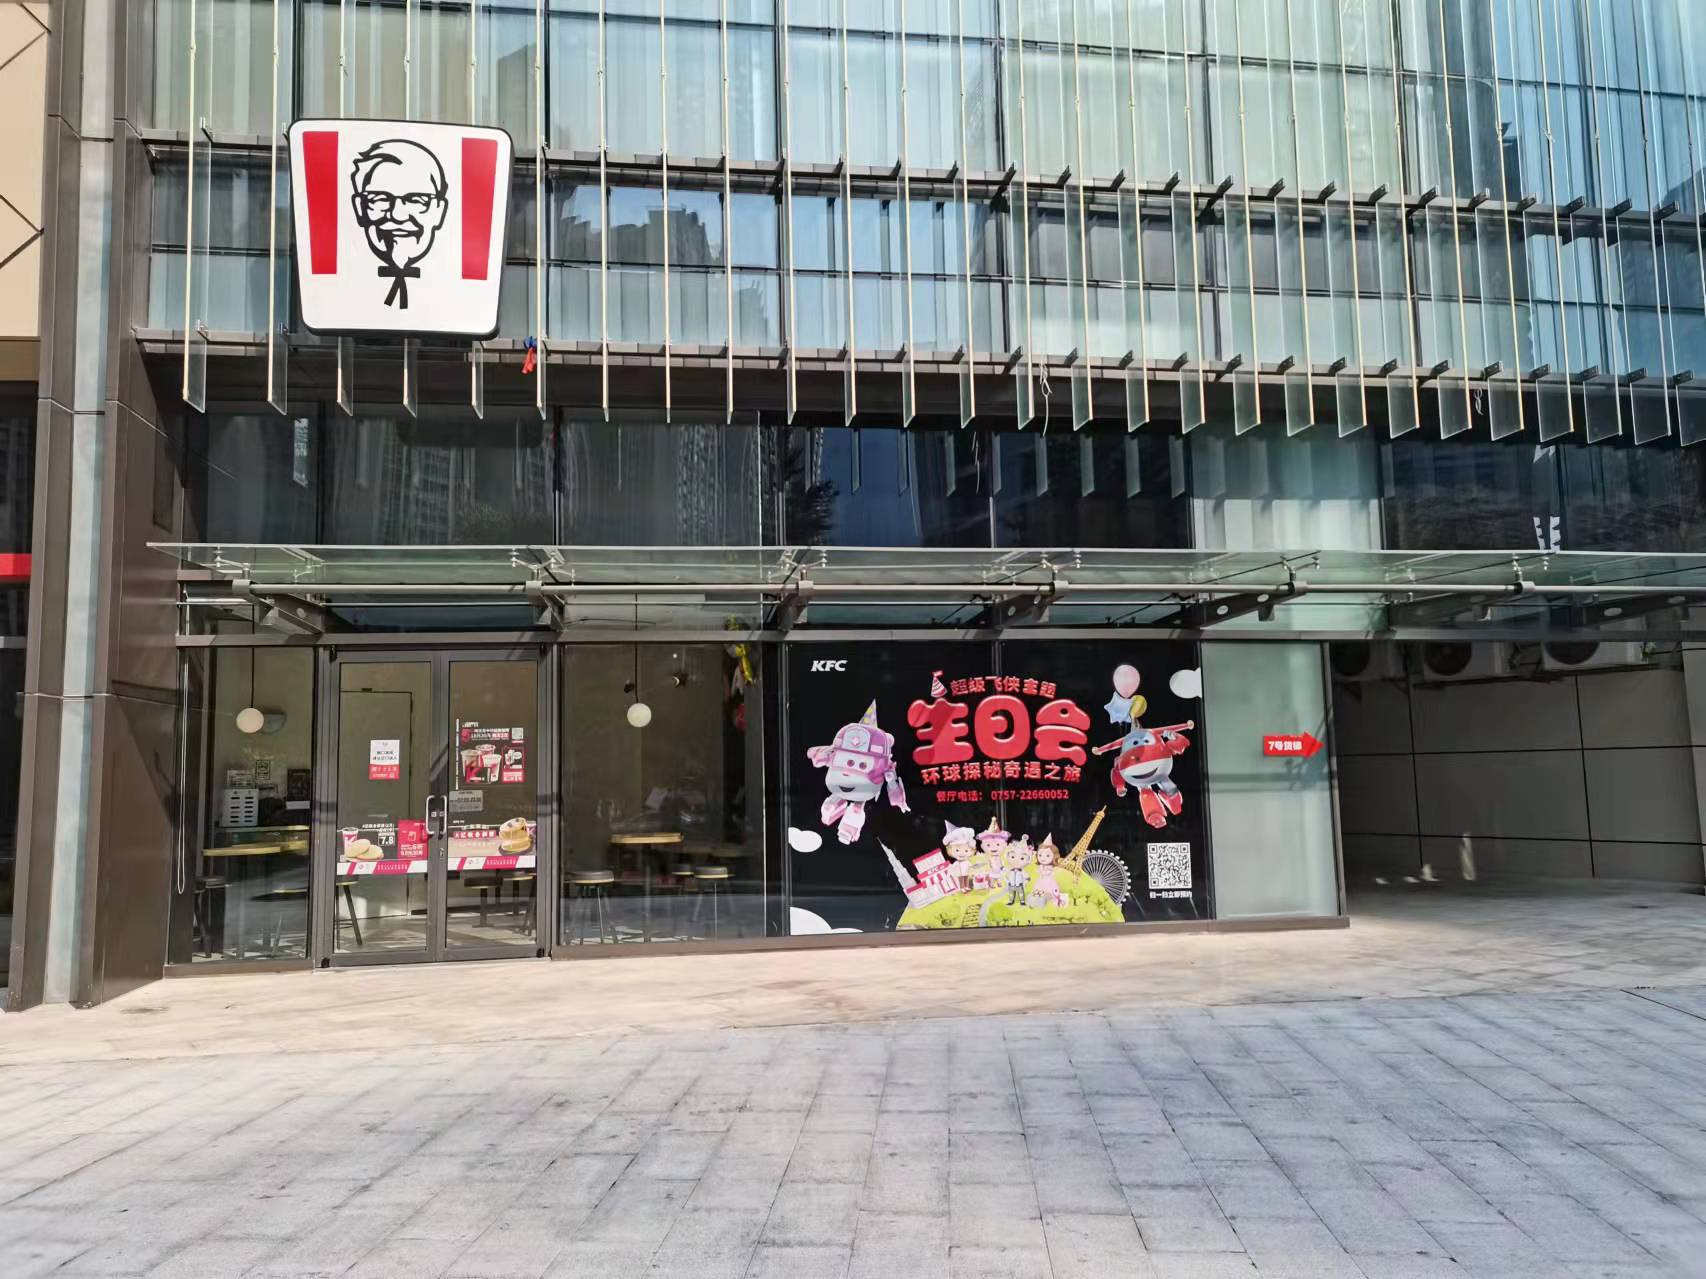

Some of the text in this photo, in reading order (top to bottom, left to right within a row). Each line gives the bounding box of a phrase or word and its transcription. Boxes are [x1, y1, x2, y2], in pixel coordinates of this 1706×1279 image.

[810, 659, 849, 672] KFC
[949, 675, 1058, 700] 超级飞侠主题
[907, 694, 1092, 767] 生日会
[920, 760, 1082, 786] 环球探秘奇遇之旅
[990, 788, 1070, 802] 0757-22660052
